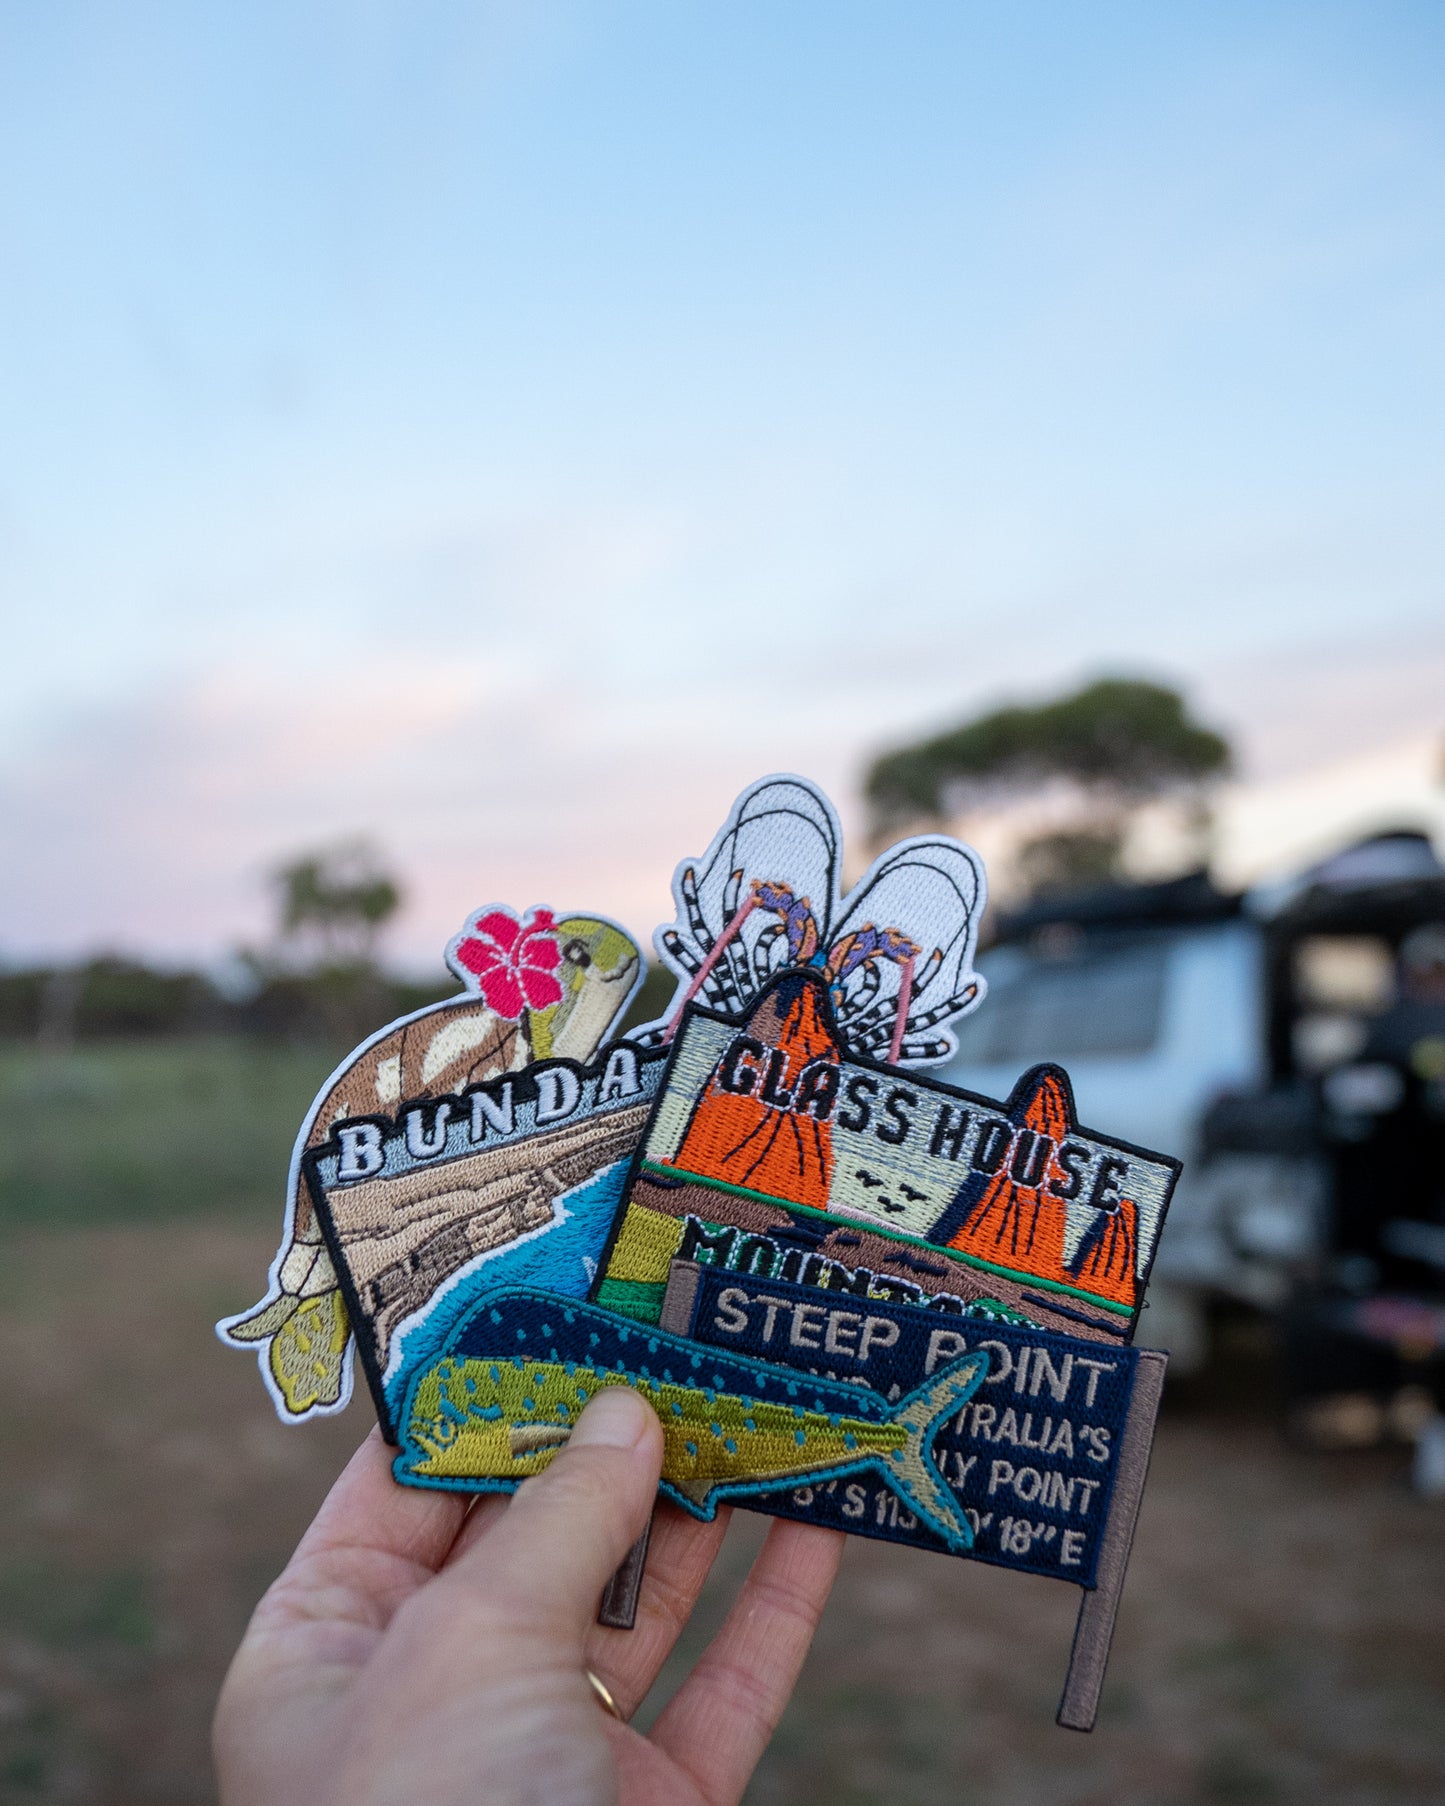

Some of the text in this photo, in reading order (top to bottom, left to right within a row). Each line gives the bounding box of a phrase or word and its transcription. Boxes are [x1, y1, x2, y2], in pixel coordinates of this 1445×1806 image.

[338, 1048, 642, 1180] BUNDA
[718, 1035, 1130, 1212] GLASS HOUSE
[714, 1287, 899, 1361] STEEP
[924, 1329, 1118, 1408] POINT
[841, 1483, 867, 1517] S
[1060, 1528, 1087, 1565] E
[988, 1459, 1101, 1515] POINT
